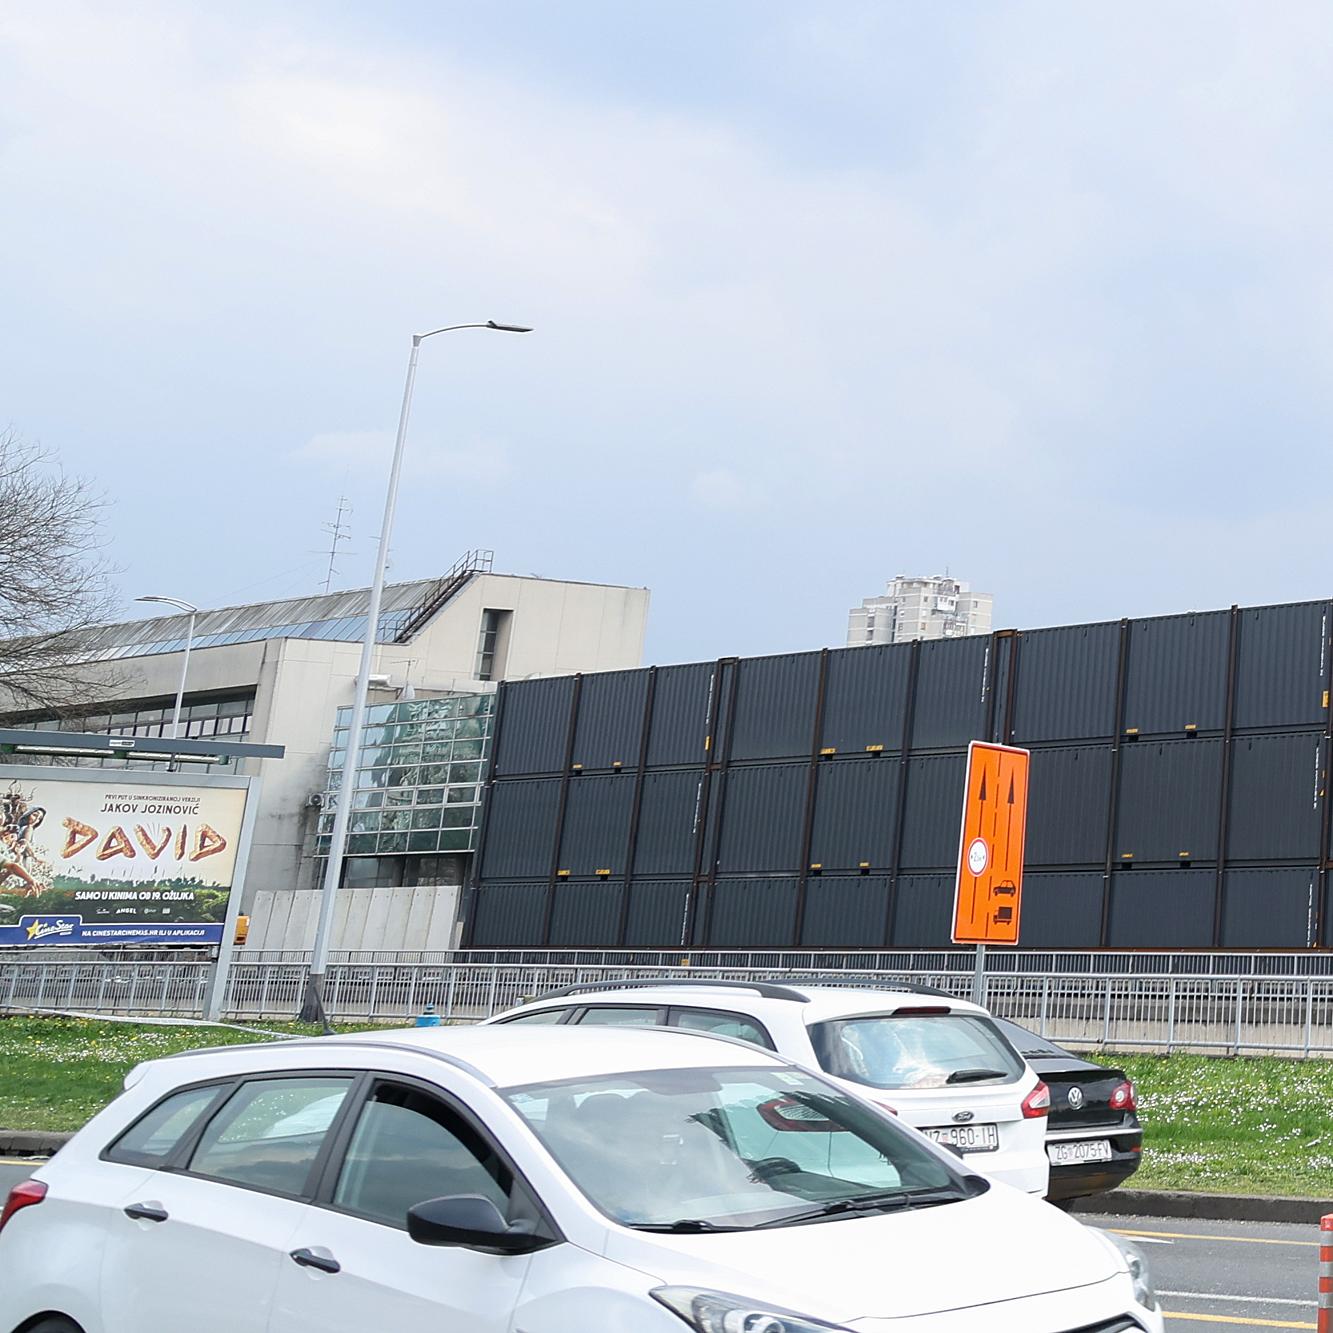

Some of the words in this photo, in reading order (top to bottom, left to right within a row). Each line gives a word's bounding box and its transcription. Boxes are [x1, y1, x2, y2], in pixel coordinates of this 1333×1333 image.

[100, 803, 139, 813] JAKOV
[141, 803, 200, 815] JOZINOVIĆ
[60, 817, 227, 862] DAVID
[75, 891, 101, 900] SAMO
[101, 891, 108, 900] U
[108, 891, 137, 900] KINIMA
[139, 892, 151, 900] OD
[162, 890, 194, 900] OŽUJKA
[35, 919, 74, 936] CineStar
[1054, 1145, 1068, 1160] ZG
